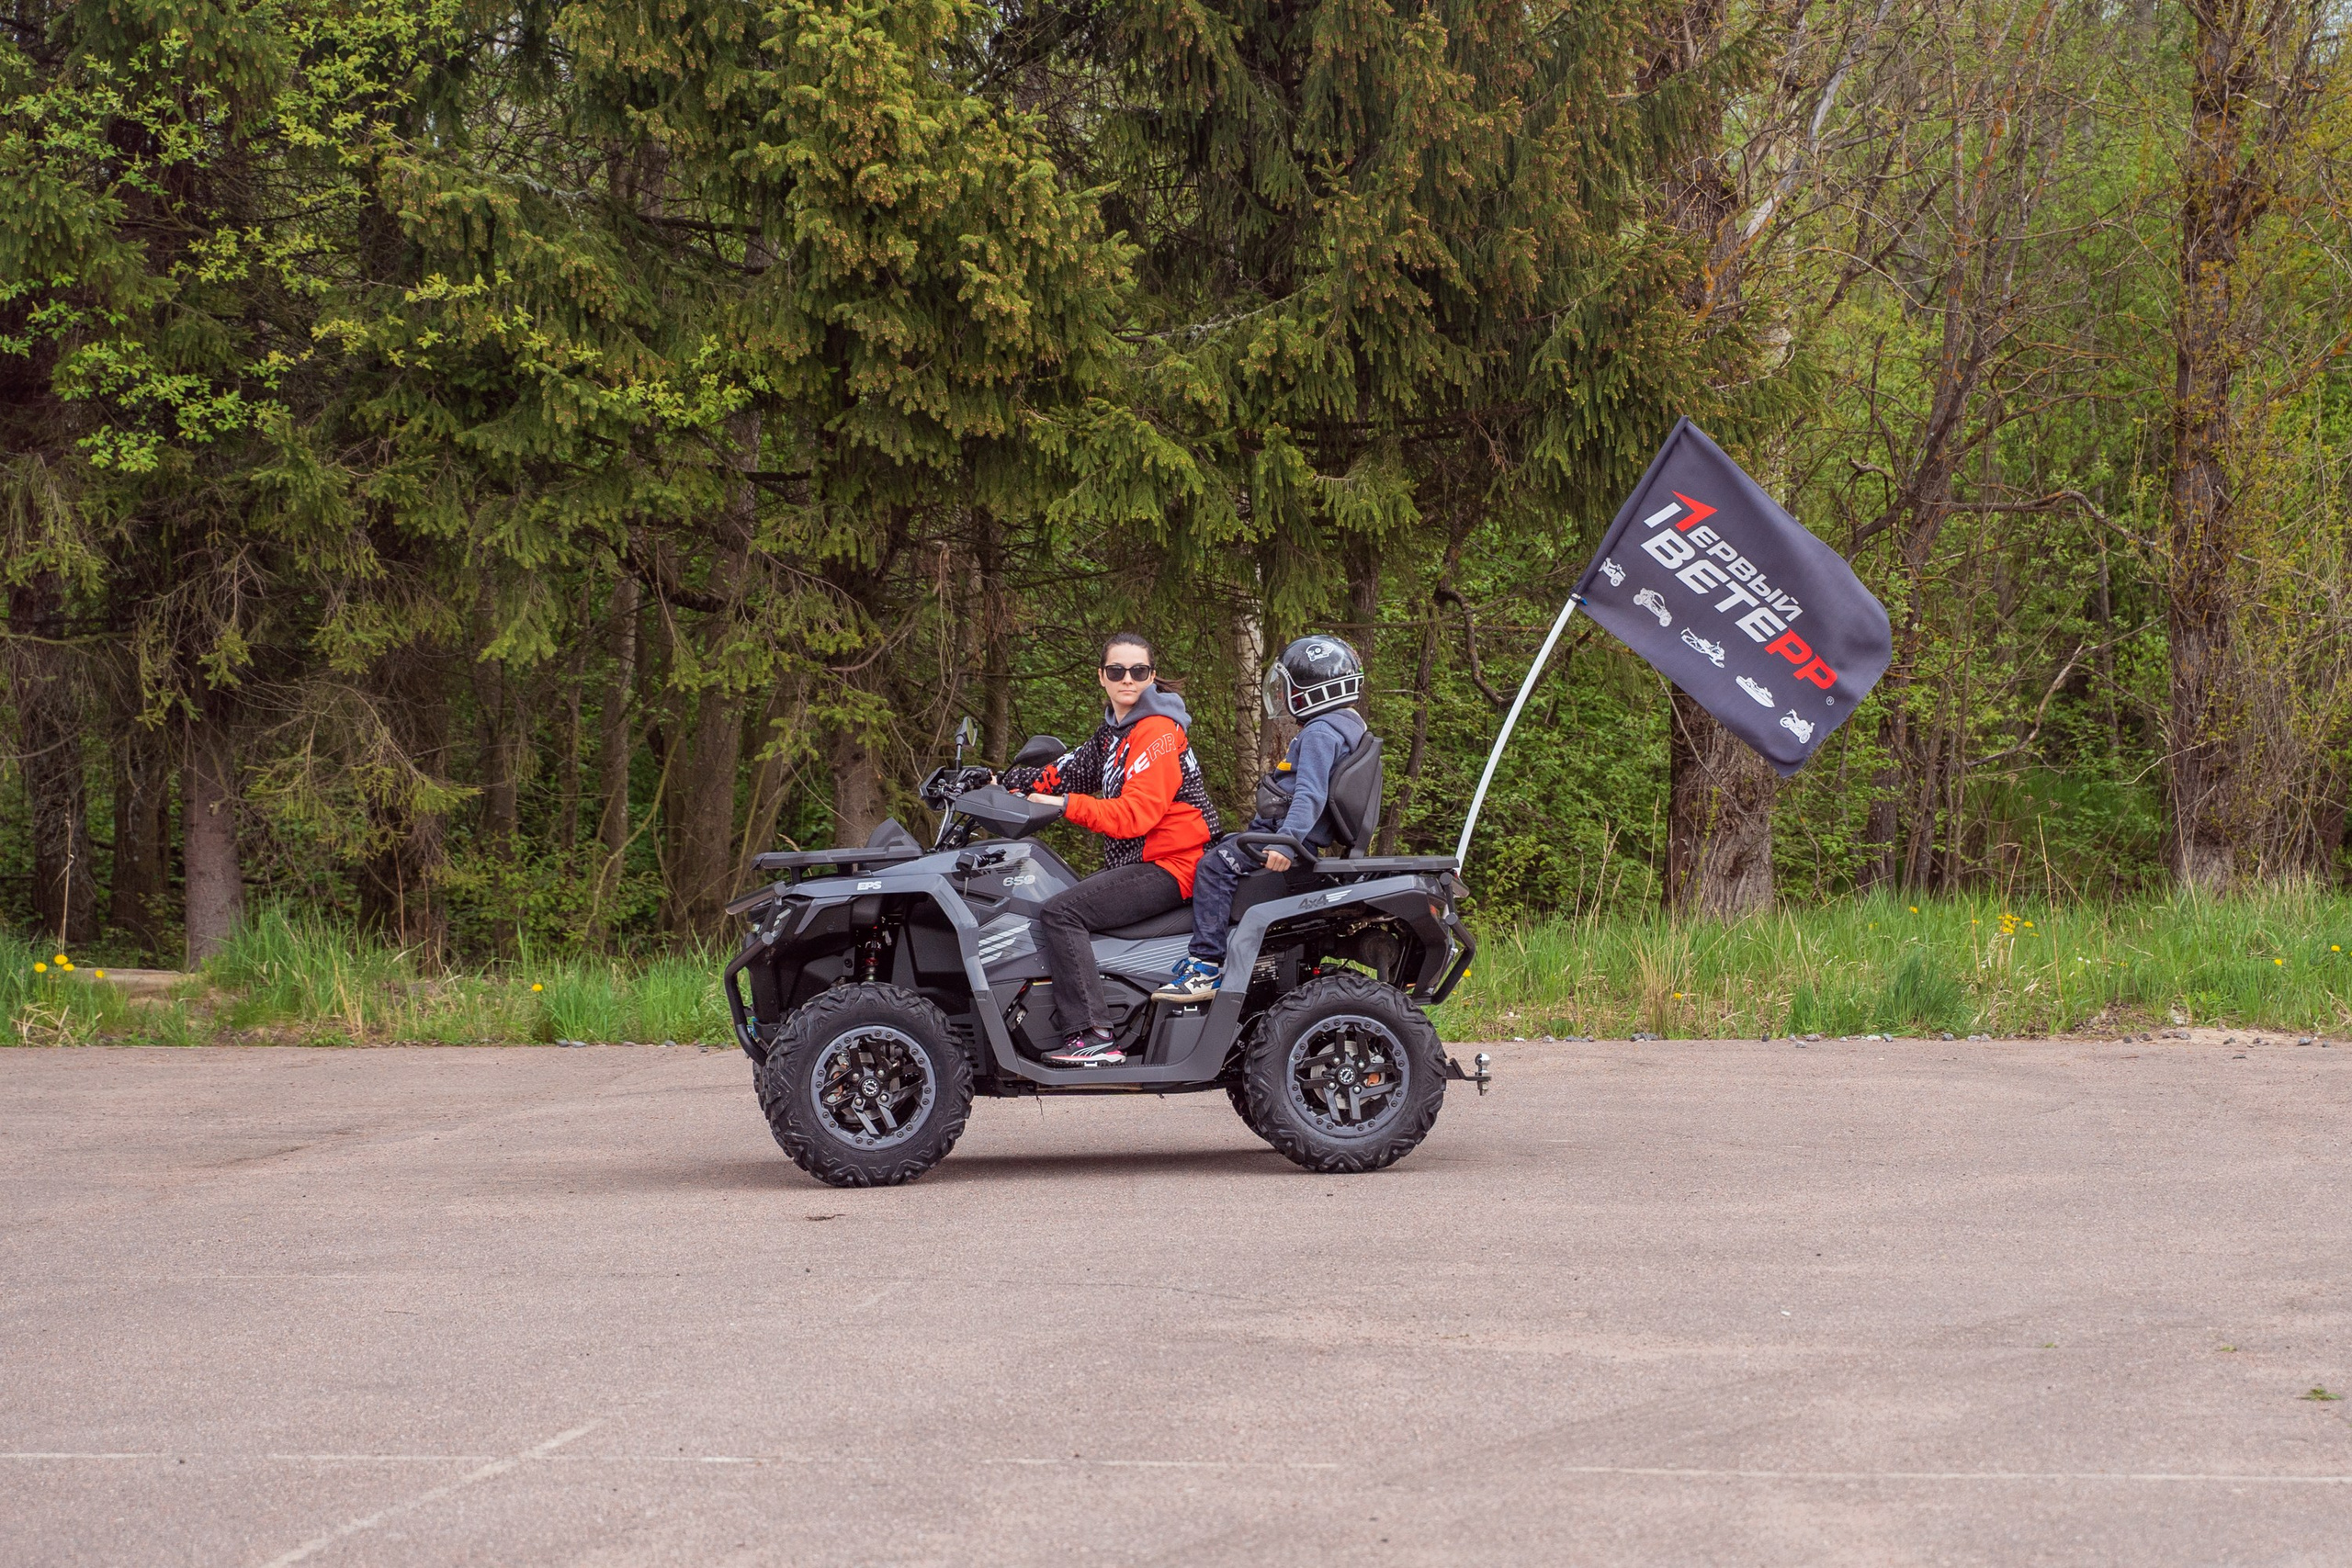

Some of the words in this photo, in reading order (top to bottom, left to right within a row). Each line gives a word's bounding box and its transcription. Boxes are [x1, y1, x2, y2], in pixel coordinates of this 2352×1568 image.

[1640, 527, 1838, 690] ВЕТЕРР
[856, 881, 882, 891] EPS
[1002, 874, 1036, 887] 650
